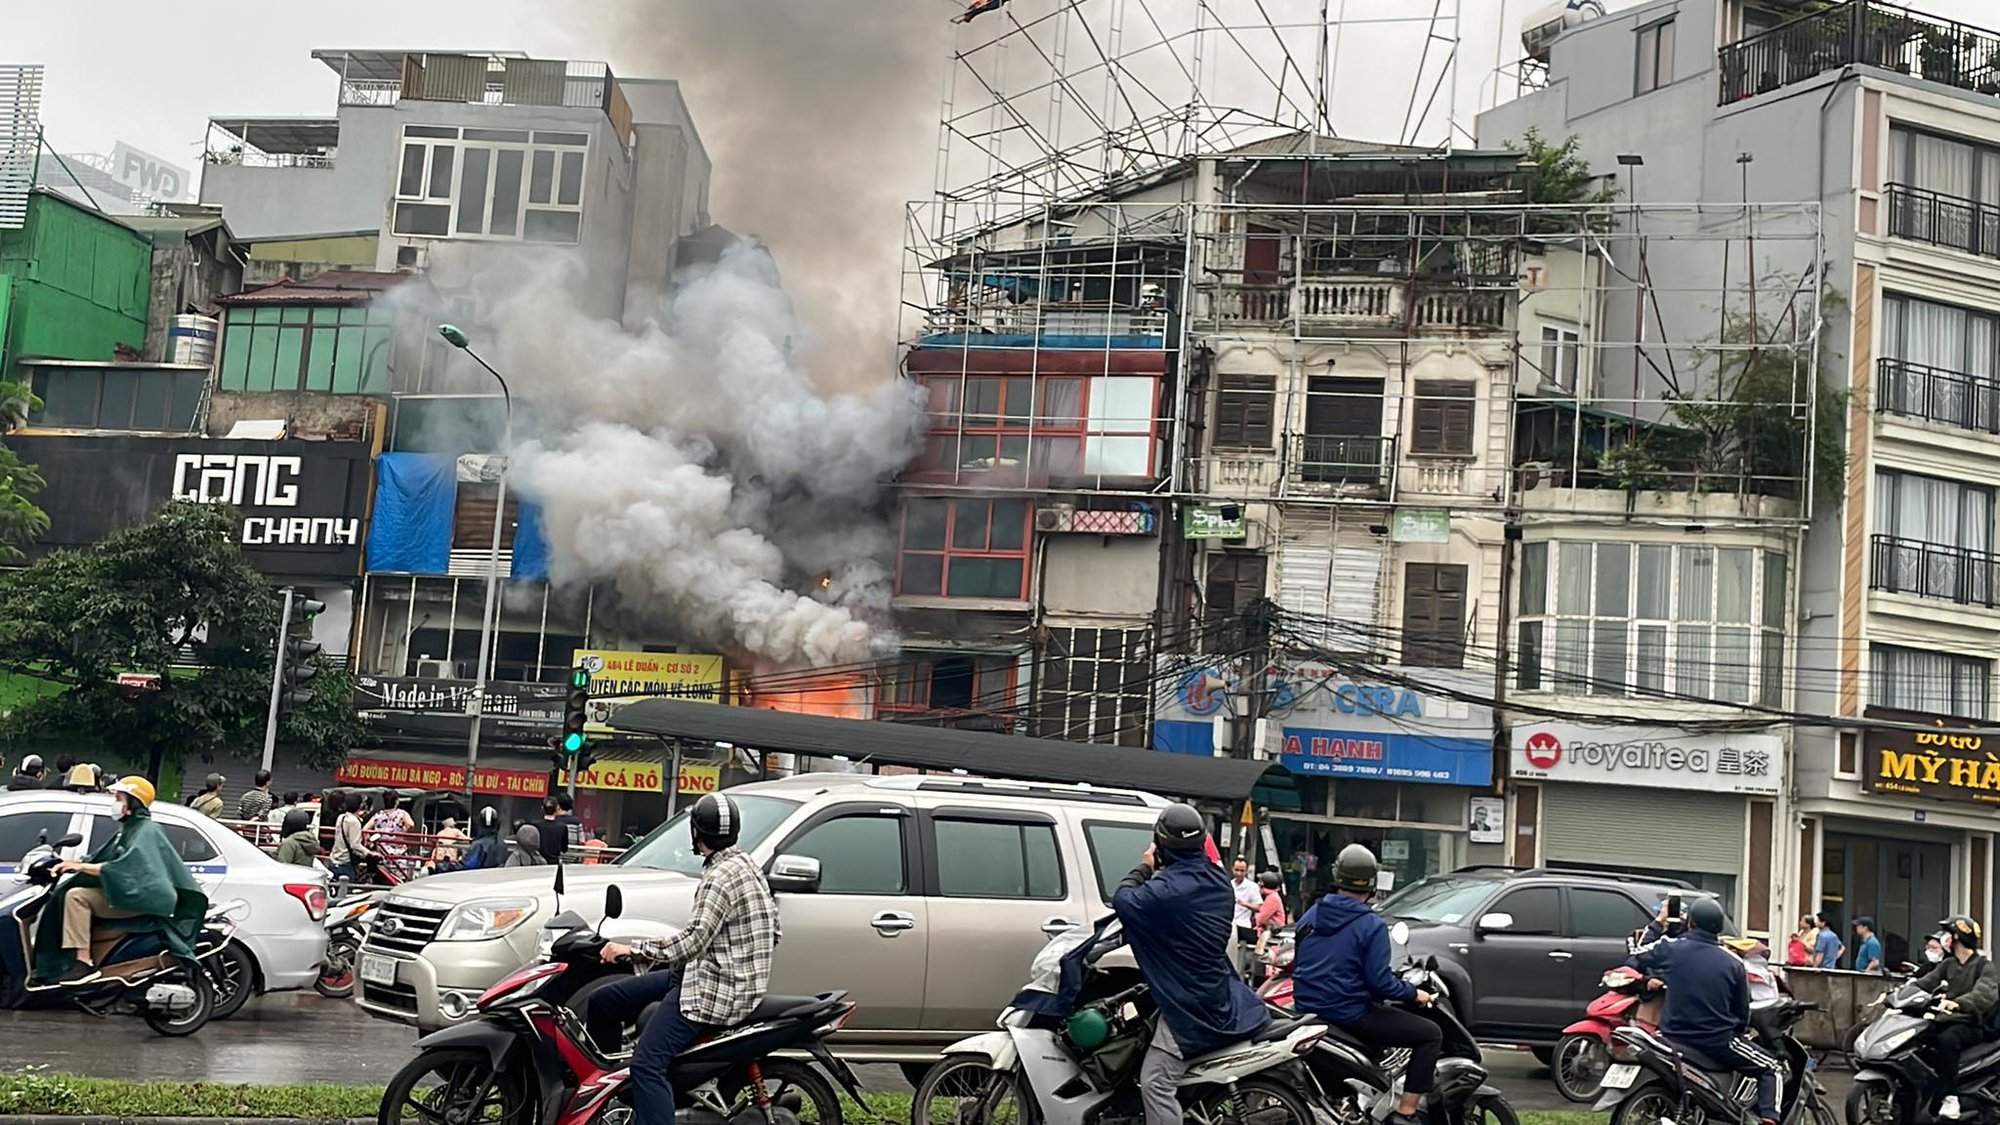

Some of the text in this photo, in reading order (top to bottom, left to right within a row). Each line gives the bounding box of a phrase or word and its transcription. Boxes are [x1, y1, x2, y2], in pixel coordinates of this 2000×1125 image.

[123, 151, 180, 199] FWD
[693, 664, 700, 675] 2
[380, 682, 426, 709] Made
[429, 684, 445, 708] in
[449, 686, 518, 714] Vinam
[1311, 737, 1383, 762] HẠNH
[1568, 740, 1710, 773] royaltea
[1716, 747, 1770, 777] 皇茶
[604, 768, 628, 787] CÁ
[633, 769, 658, 788] RÔ
[1880, 749, 1947, 783] MỸ
